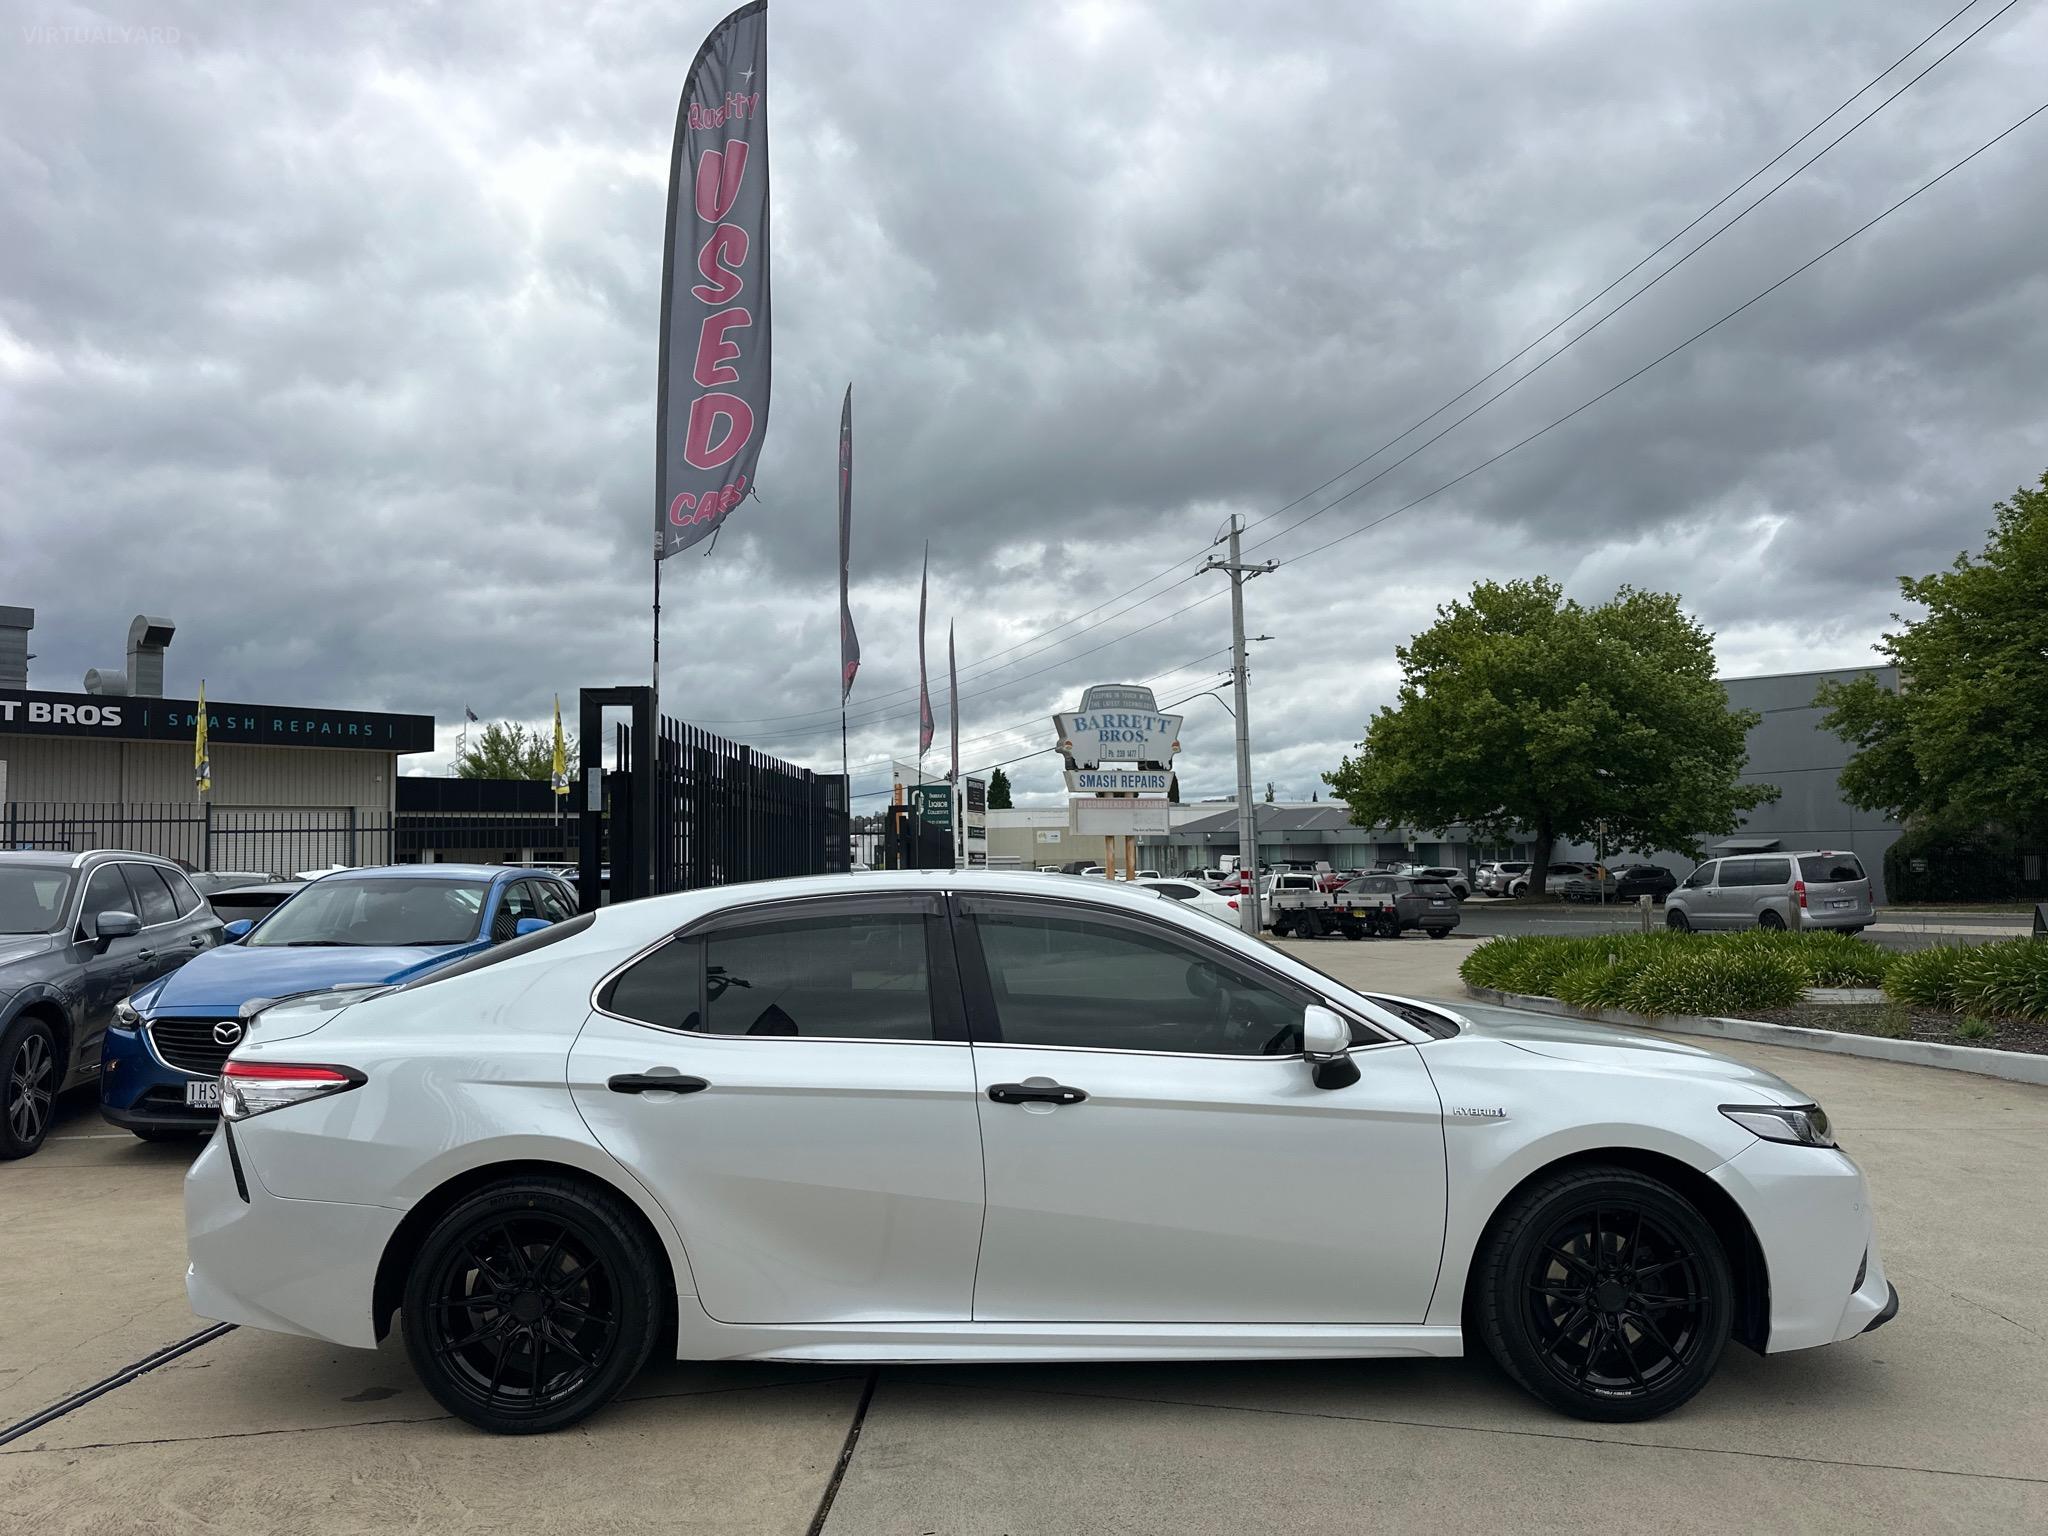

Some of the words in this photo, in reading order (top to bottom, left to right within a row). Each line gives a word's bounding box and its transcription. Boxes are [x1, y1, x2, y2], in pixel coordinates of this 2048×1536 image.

[687, 91, 760, 130] Quaity
[683, 138, 755, 471] USED
[28, 702, 122, 727] BROS
[1073, 713, 1172, 734] BARRETT
[168, 713, 255, 730] SMASH
[273, 719, 373, 736] REPAIRS
[1099, 729, 1149, 743] BROS.
[1079, 774, 1117, 788] SMASH
[1121, 775, 1165, 788] REPAIRS
[1078, 800, 1132, 809] RECOMMENDED
[1134, 800, 1168, 809] REPAIRER
[191, 1083, 217, 1100] 1HS
[1453, 1106, 1498, 1117] HYBRID
